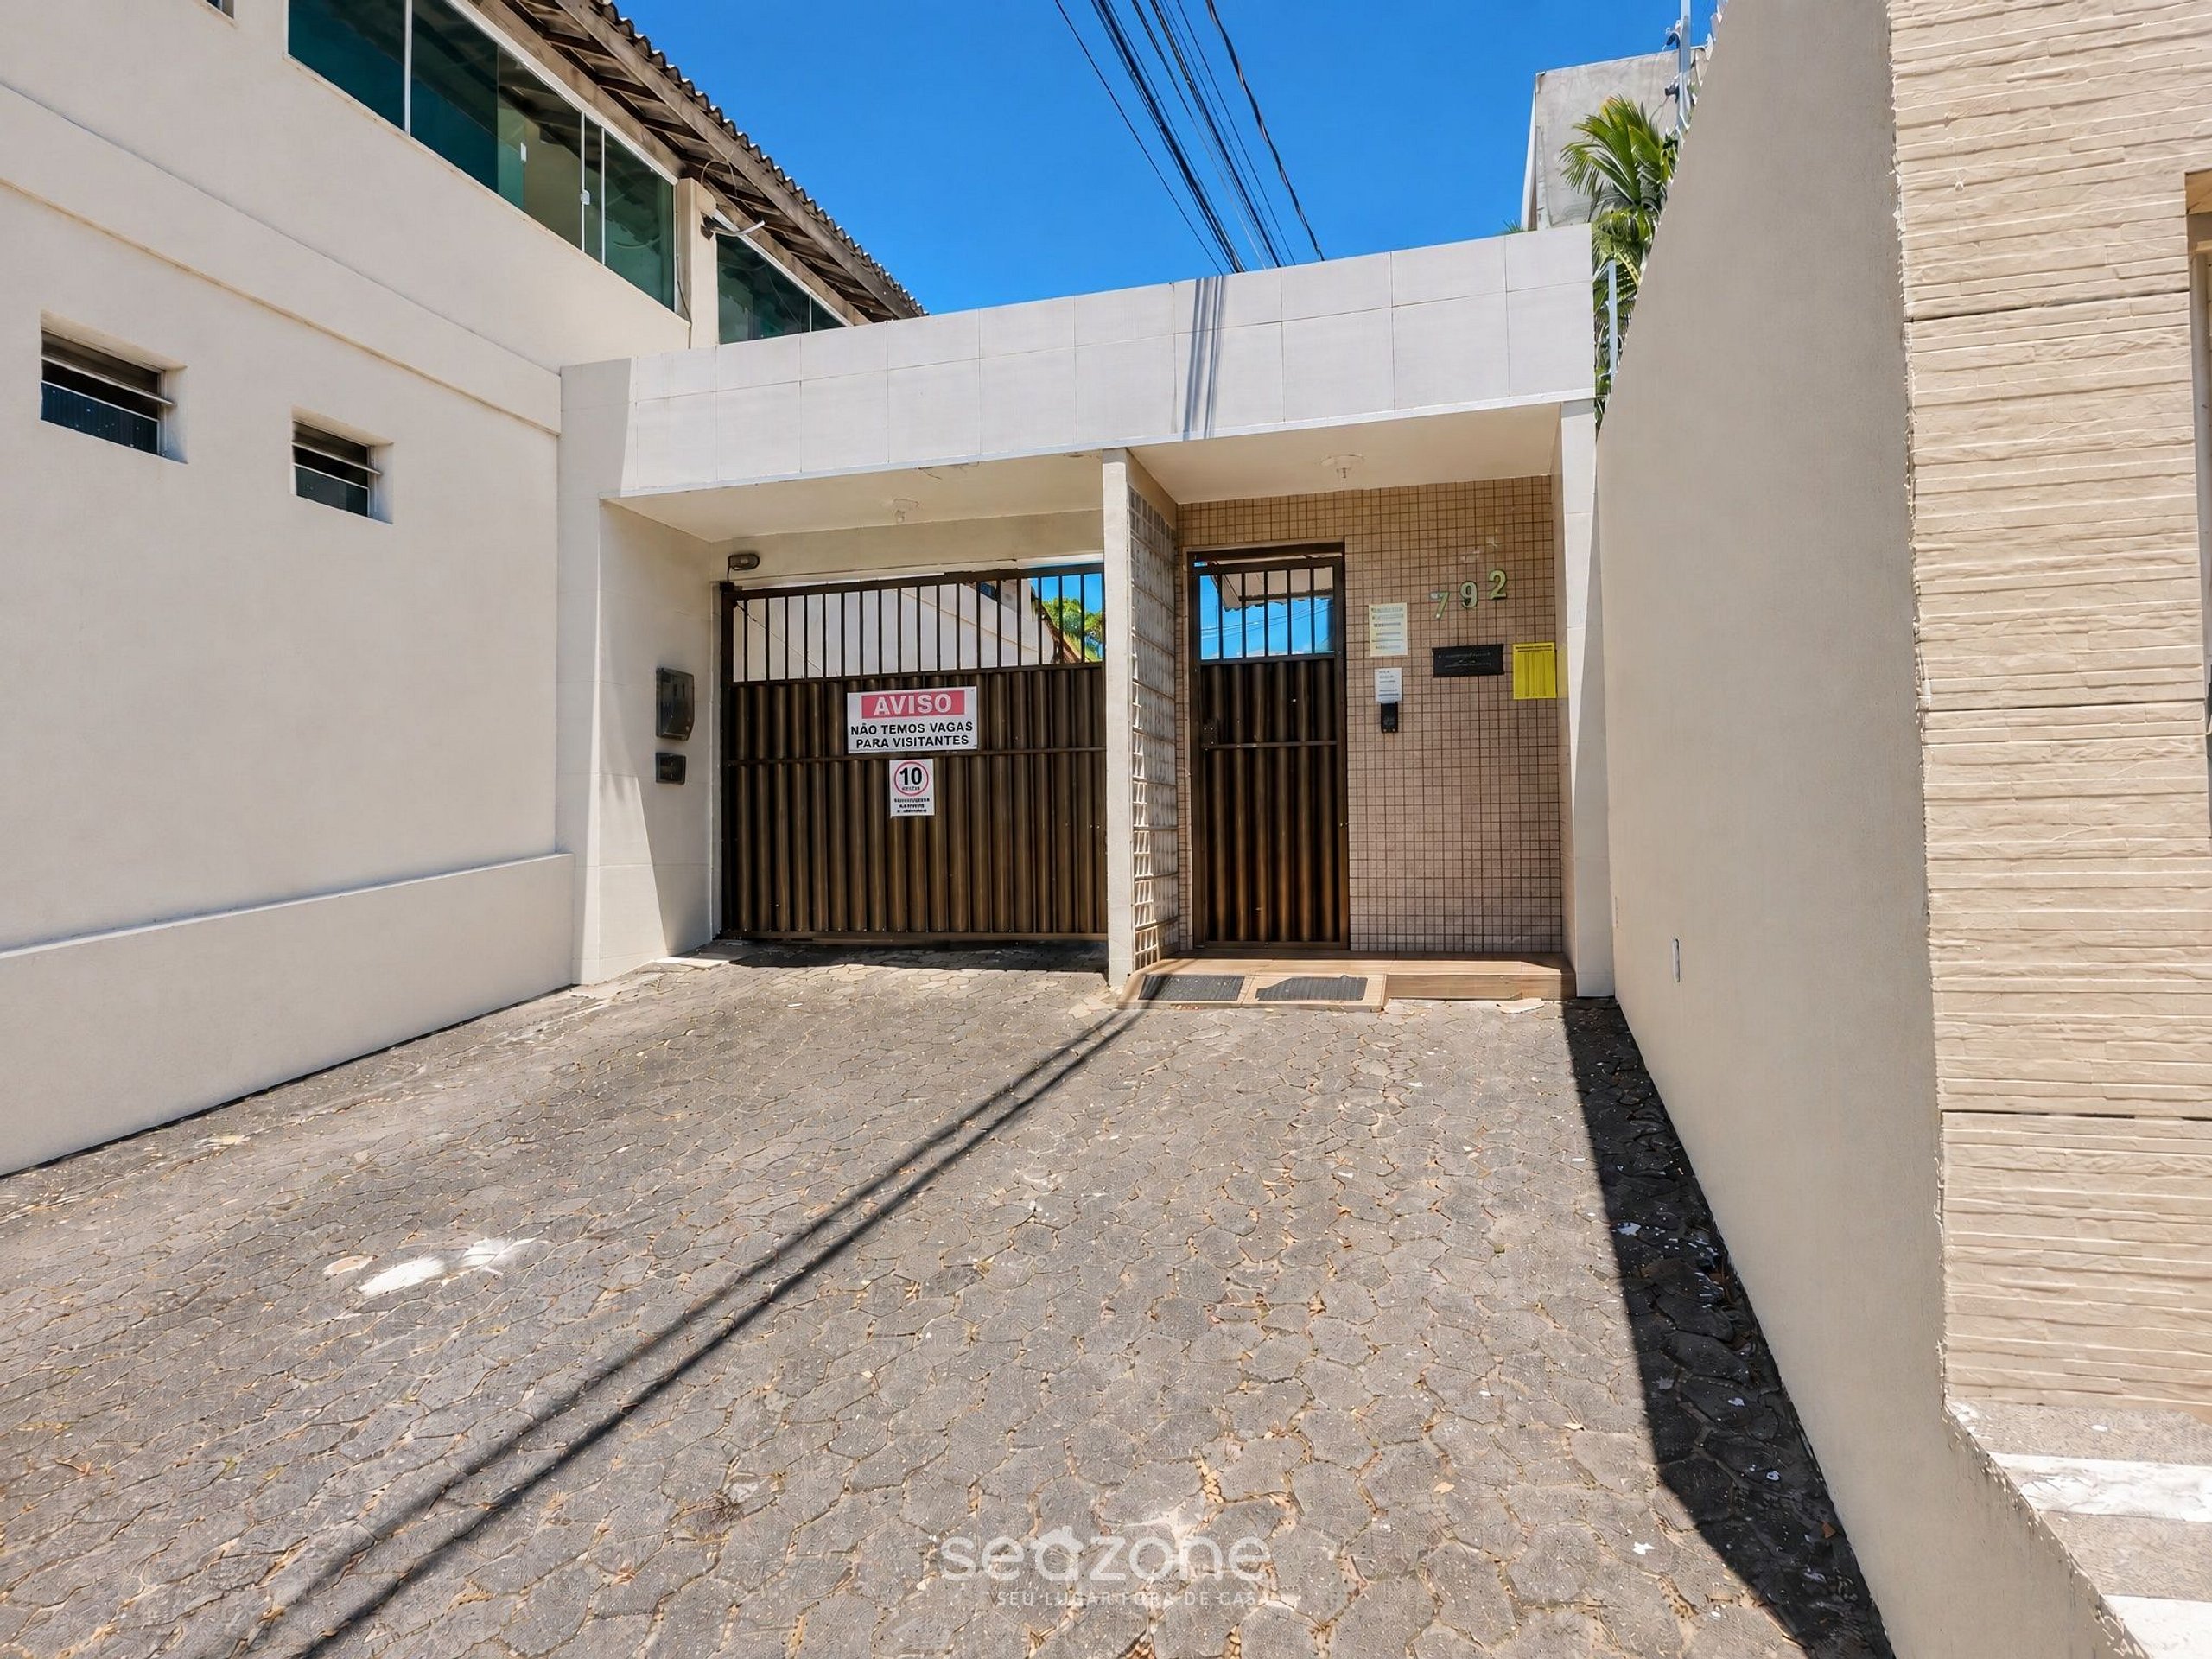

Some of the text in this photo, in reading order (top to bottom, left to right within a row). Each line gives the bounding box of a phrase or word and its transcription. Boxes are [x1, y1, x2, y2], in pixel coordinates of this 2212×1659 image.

[1429, 569, 1507, 620] 792
[874, 693, 952, 716] AVISO
[851, 721, 973, 735] NÃO TEMOS VAGAS
[856, 735, 969, 748] PARA VISITANTES
[899, 766, 922, 785] 10
